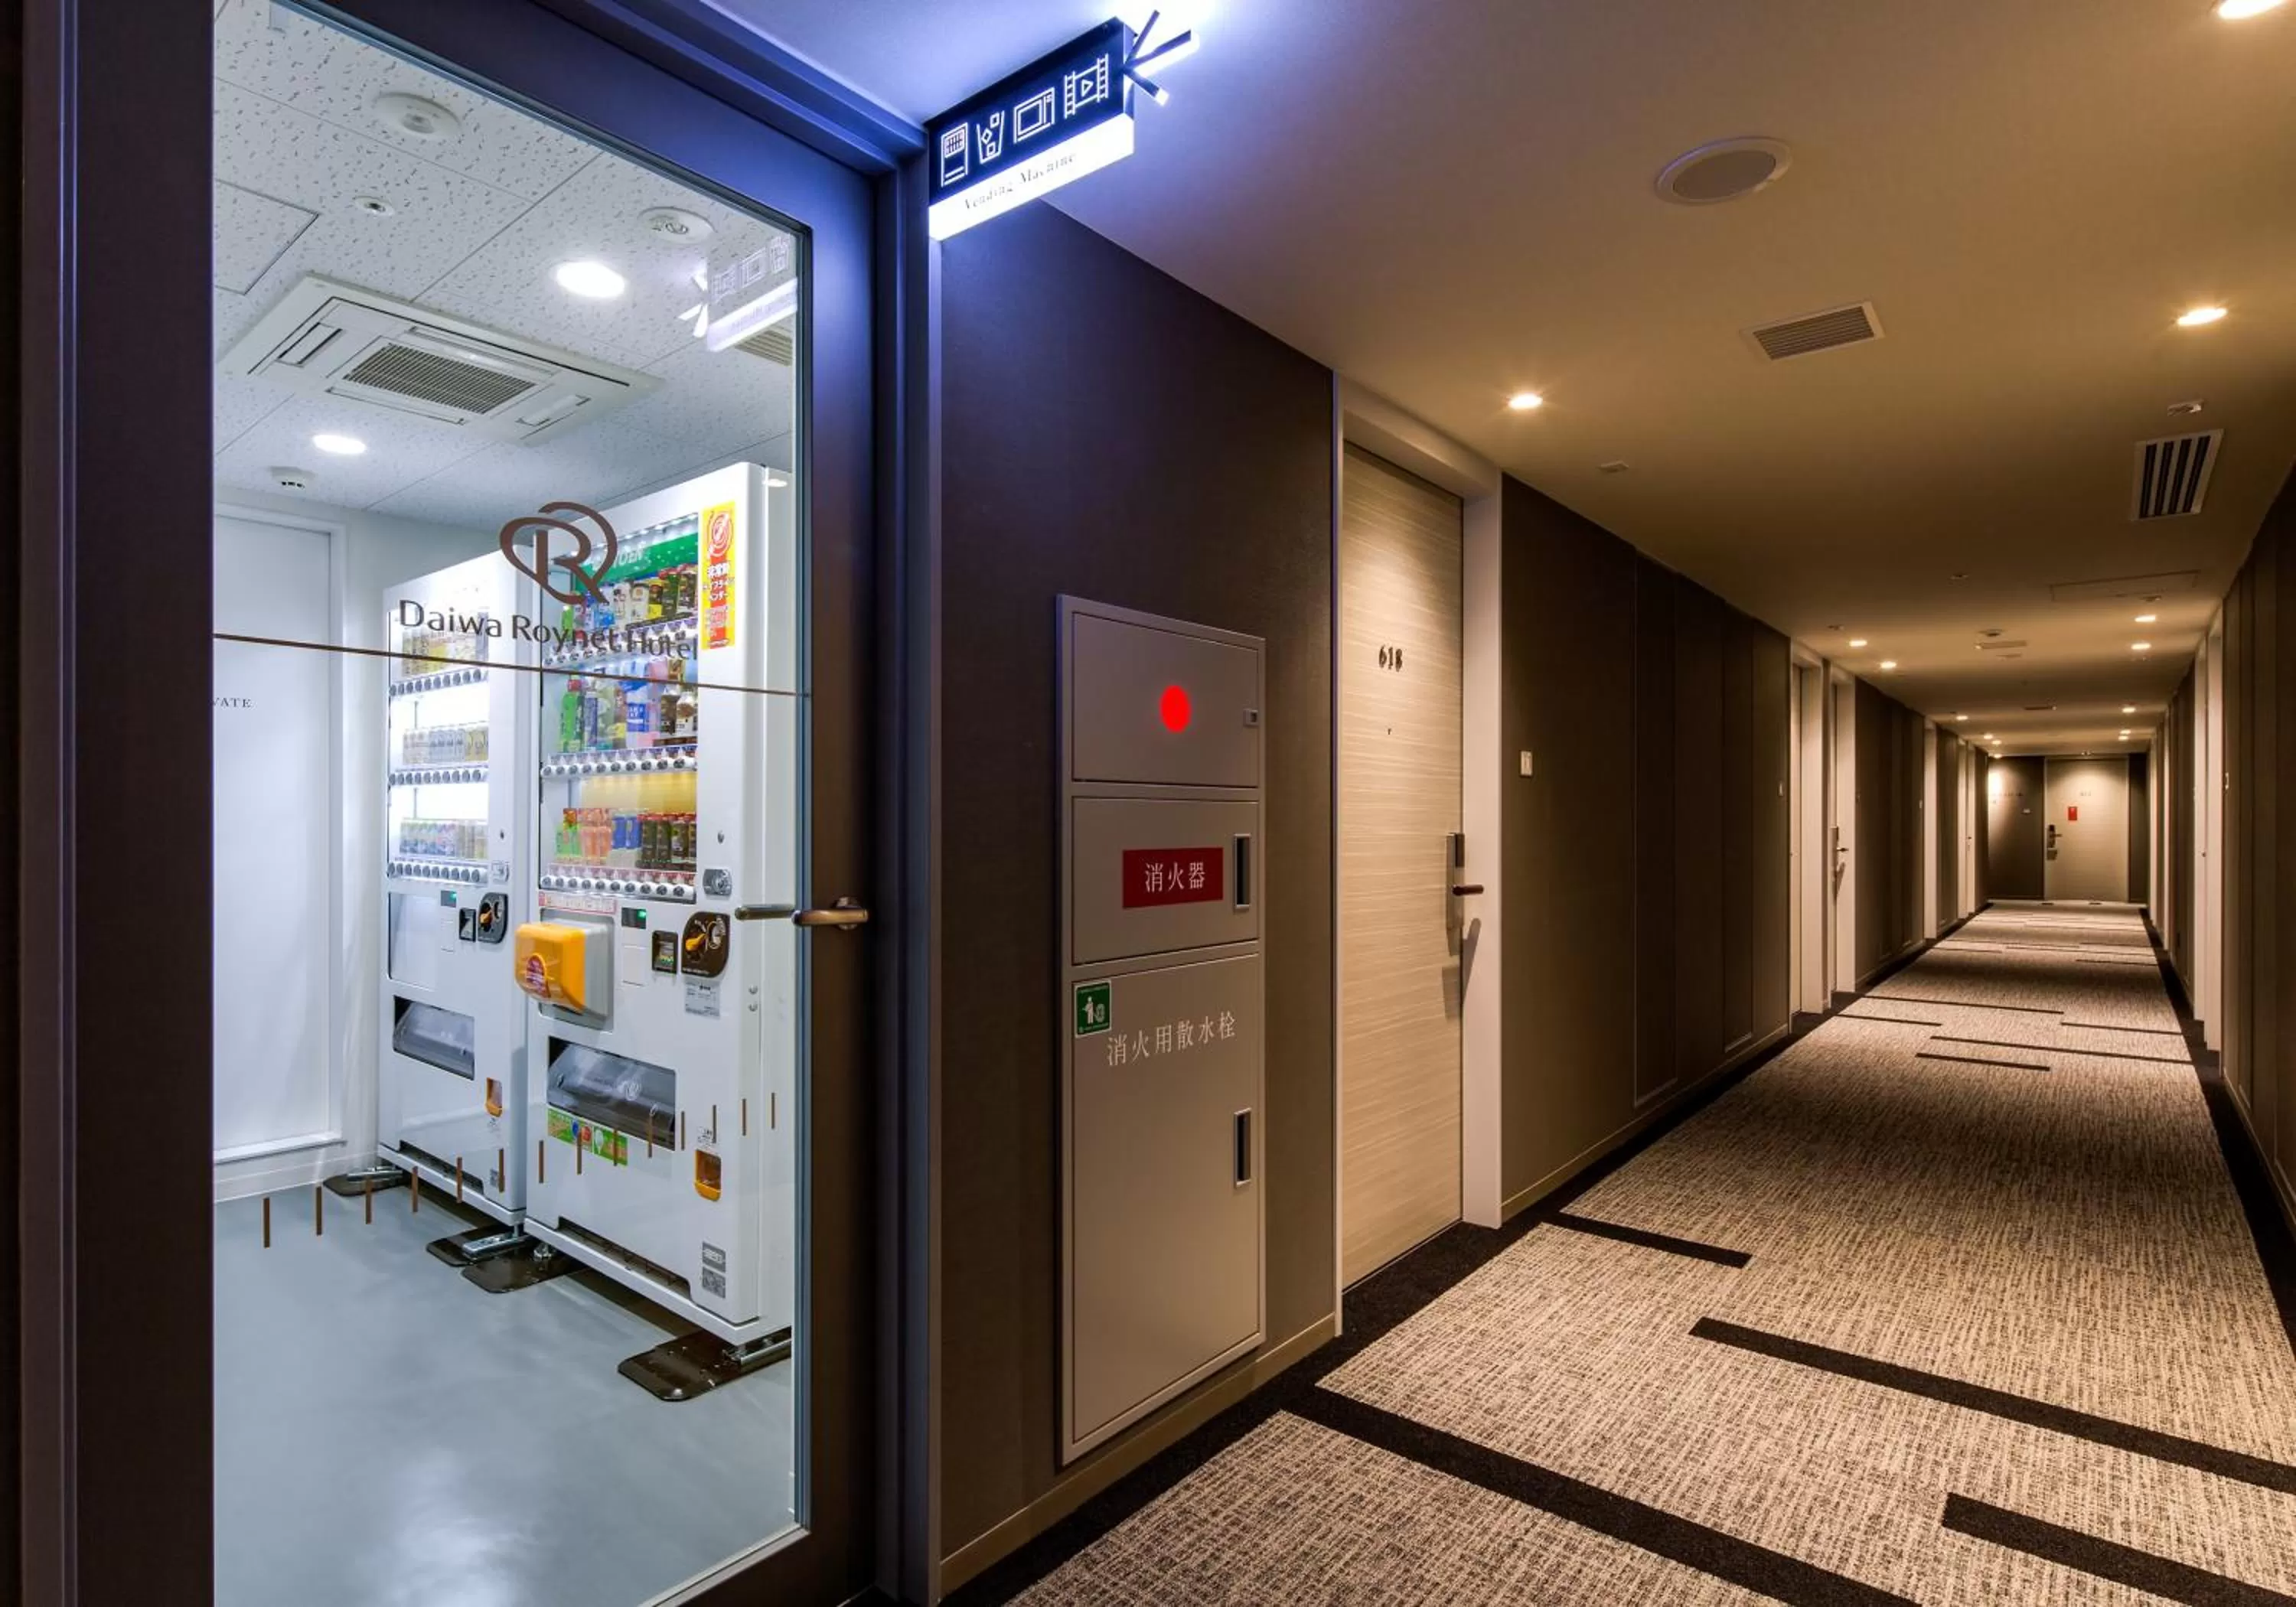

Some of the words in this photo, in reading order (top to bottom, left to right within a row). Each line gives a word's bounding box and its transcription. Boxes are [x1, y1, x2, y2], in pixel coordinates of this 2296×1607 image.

[400, 599, 502, 637] Daiwa
[512, 614, 618, 653] Roynet
[627, 630, 697, 660] Hotel
[1379, 644, 1402, 672] 618
[1145, 861, 1205, 894] 消火器
[1107, 1009, 1236, 1066] 消火用散水栓
